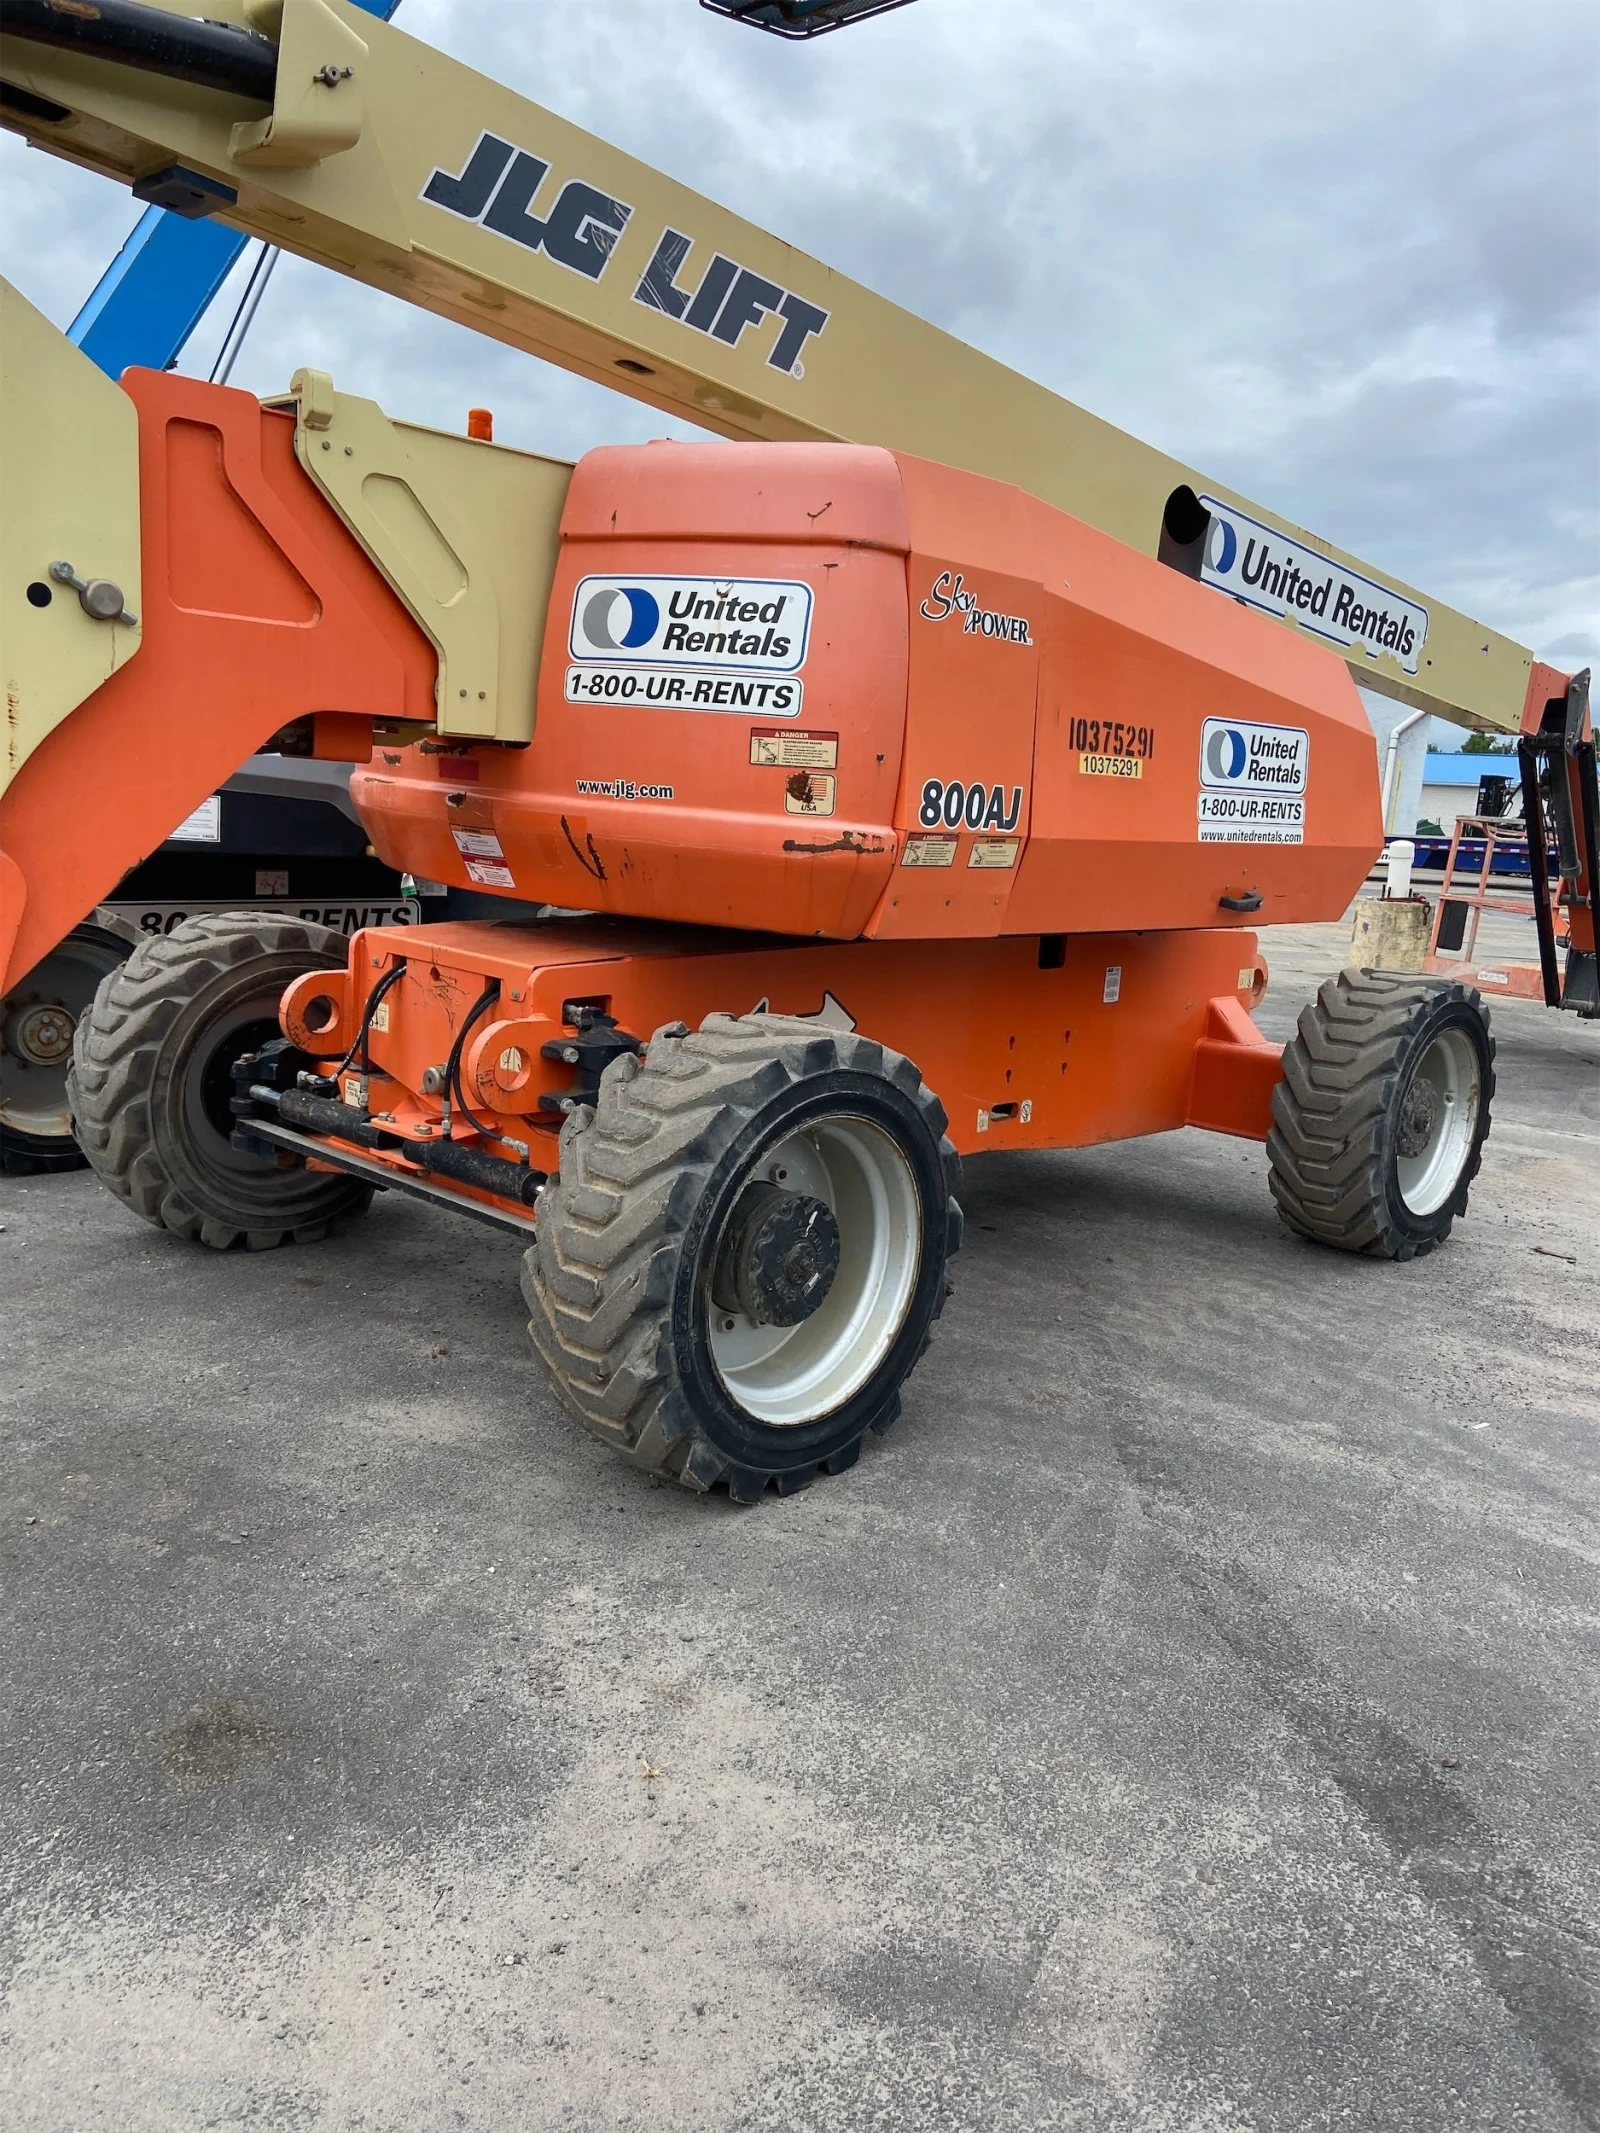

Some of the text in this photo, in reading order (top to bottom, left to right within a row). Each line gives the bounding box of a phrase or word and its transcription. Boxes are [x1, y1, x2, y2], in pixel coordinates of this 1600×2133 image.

[421, 130, 830, 372] JLG LIFT
[668, 590, 788, 624] United
[920, 571, 1028, 643] Sky POWER
[1241, 538, 1415, 657] United Rentals
[662, 622, 792, 658] Rentals
[571, 673, 793, 709] 1-800-UR-RENTS
[780, 731, 809, 739] DANGER
[1069, 717, 1155, 759] 10375291
[1249, 735, 1299, 761] United
[1082, 757, 1140, 777] 10375291
[1247, 758, 1302, 784] Rentals
[576, 779, 674, 799] www.jlg.com
[921, 781, 1023, 831] 800AJ
[800, 804, 817, 812] USA
[1201, 798, 1303, 820] 1-800-UR-RENTS
